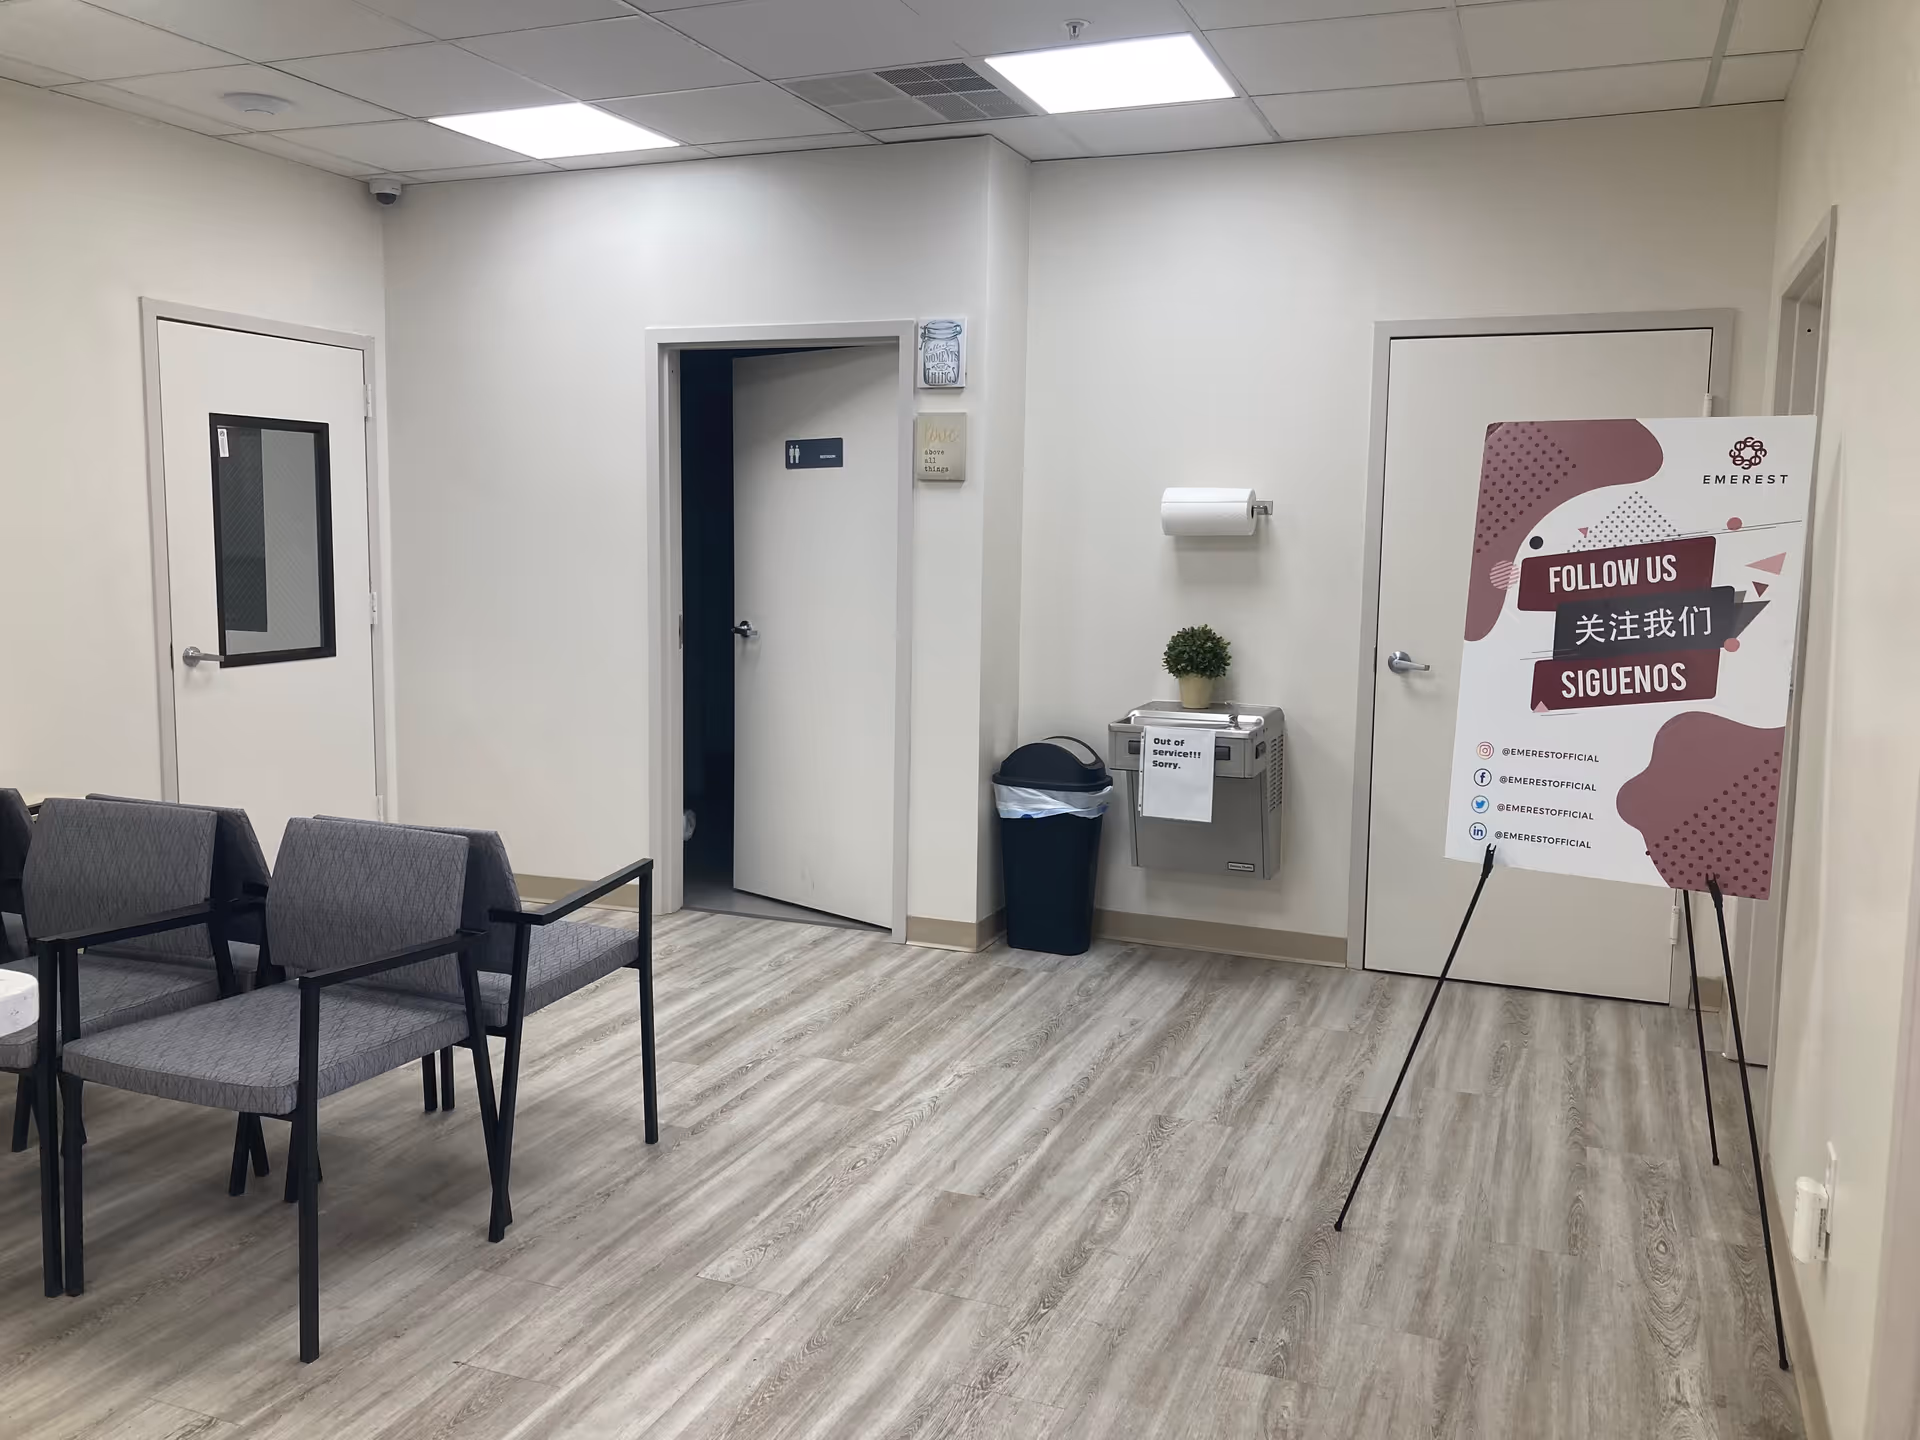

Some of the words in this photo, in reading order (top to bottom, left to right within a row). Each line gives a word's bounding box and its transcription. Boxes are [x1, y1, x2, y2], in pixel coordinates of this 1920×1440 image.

[925, 349, 959, 362] MOMENTS
[926, 366, 957, 384] THINGS
[924, 465, 950, 474] things
[1702, 474, 1789, 485] EMEREST
[1549, 558, 1640, 593] FOLLOW
[1646, 554, 1678, 583] US
[1575, 605, 1713, 646] 关注我们
[1561, 662, 1687, 699] SIGUENOS
[1153, 738, 1172, 746] Out
[1153, 749, 1201, 758] service!!!
[1502, 747, 1600, 763] @EMERESTOFFICIAL
[1153, 760, 1181, 769] Sorry.
[1499, 775, 1597, 792] @EMERESTOFFICIAL
[1496, 803, 1594, 821] @EMERESTOFFICIAL
[1494, 831, 1592, 849] @EMERESTOFFICIAL
